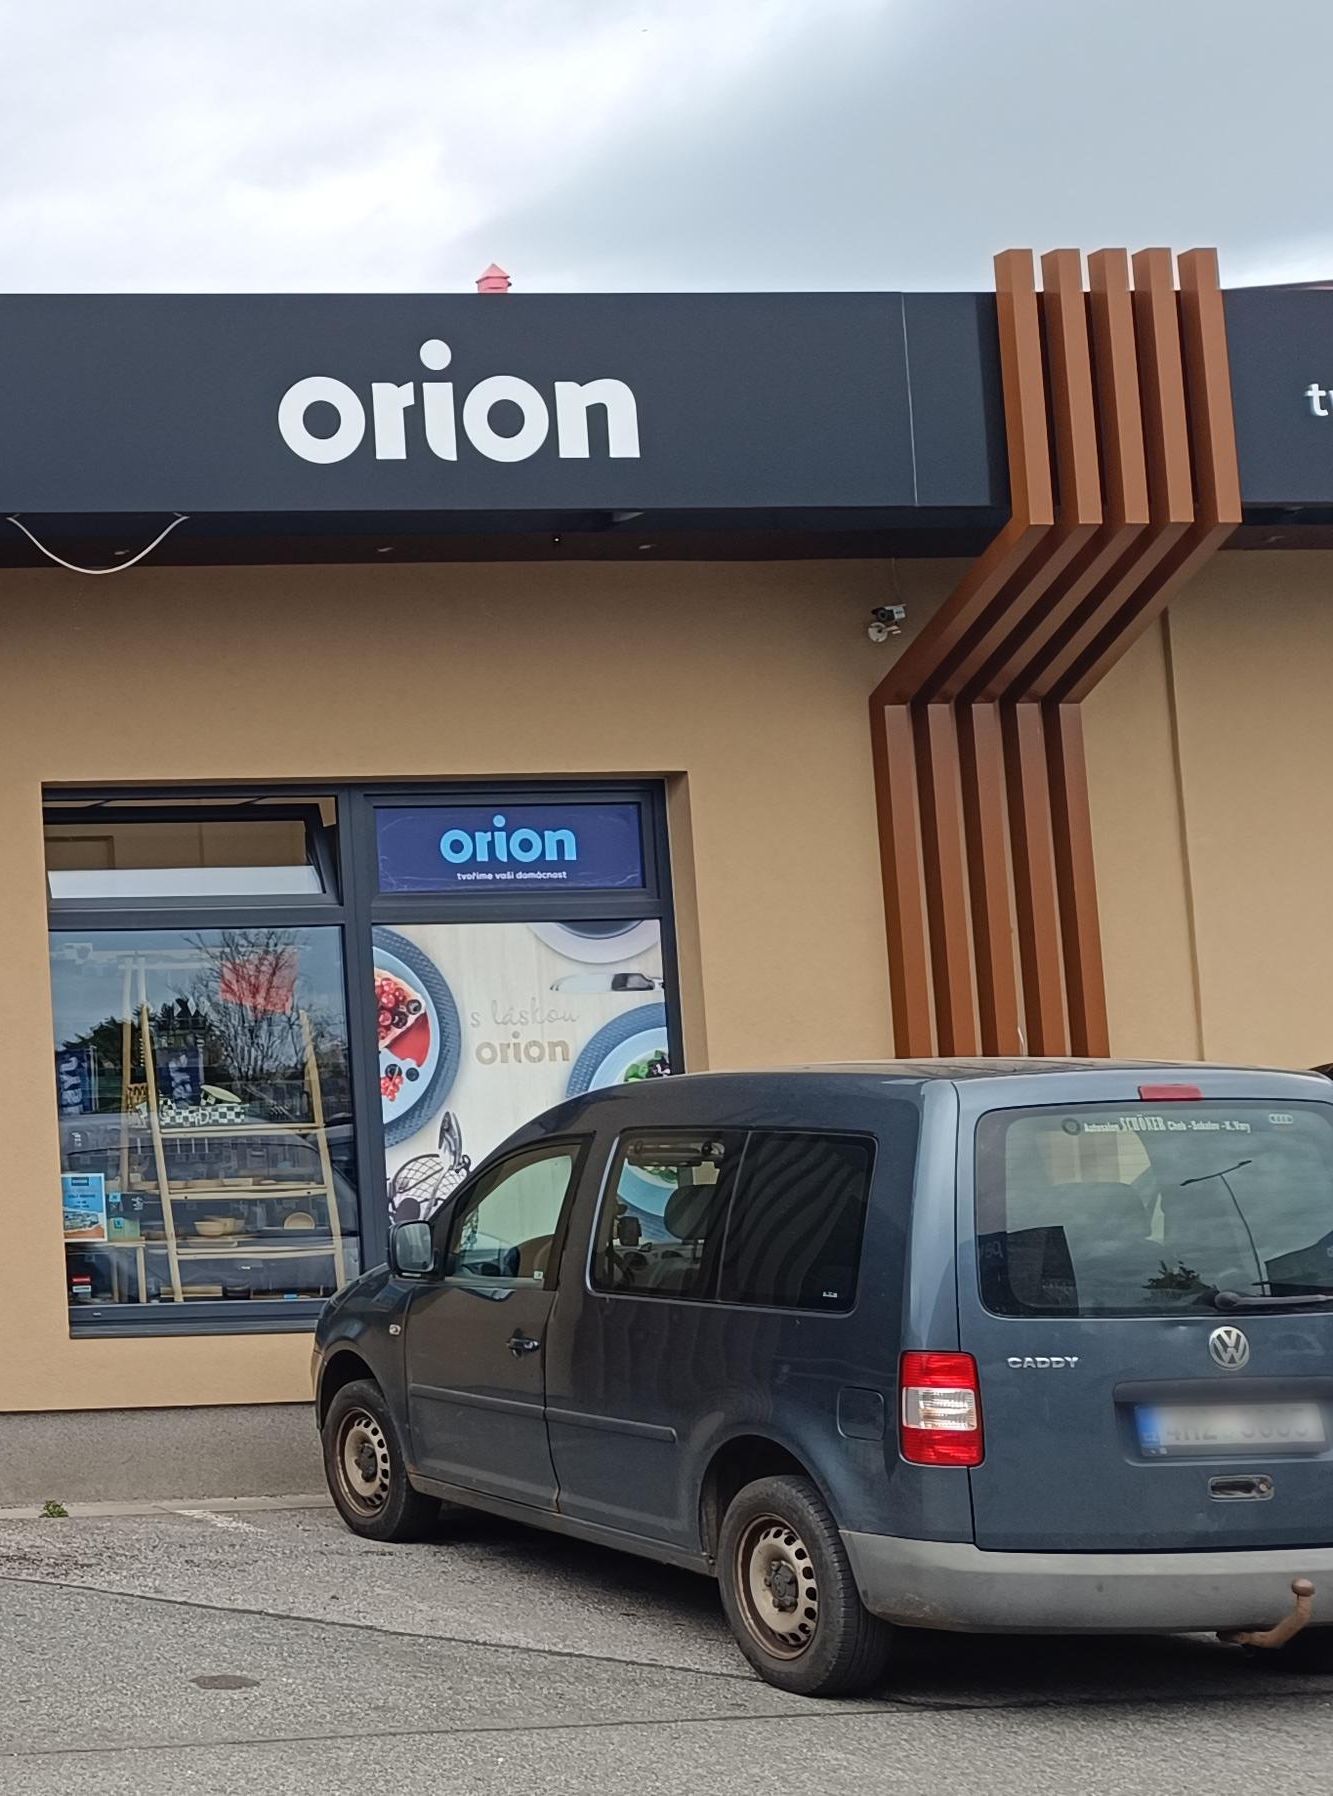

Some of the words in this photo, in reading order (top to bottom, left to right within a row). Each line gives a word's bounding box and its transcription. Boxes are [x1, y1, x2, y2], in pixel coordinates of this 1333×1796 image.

[278, 339, 640, 464] orion
[440, 815, 577, 863] orion
[516, 870, 567, 880] domácnost
[476, 1030, 570, 1065] orion
[1007, 1356, 1079, 1369] CADDY
